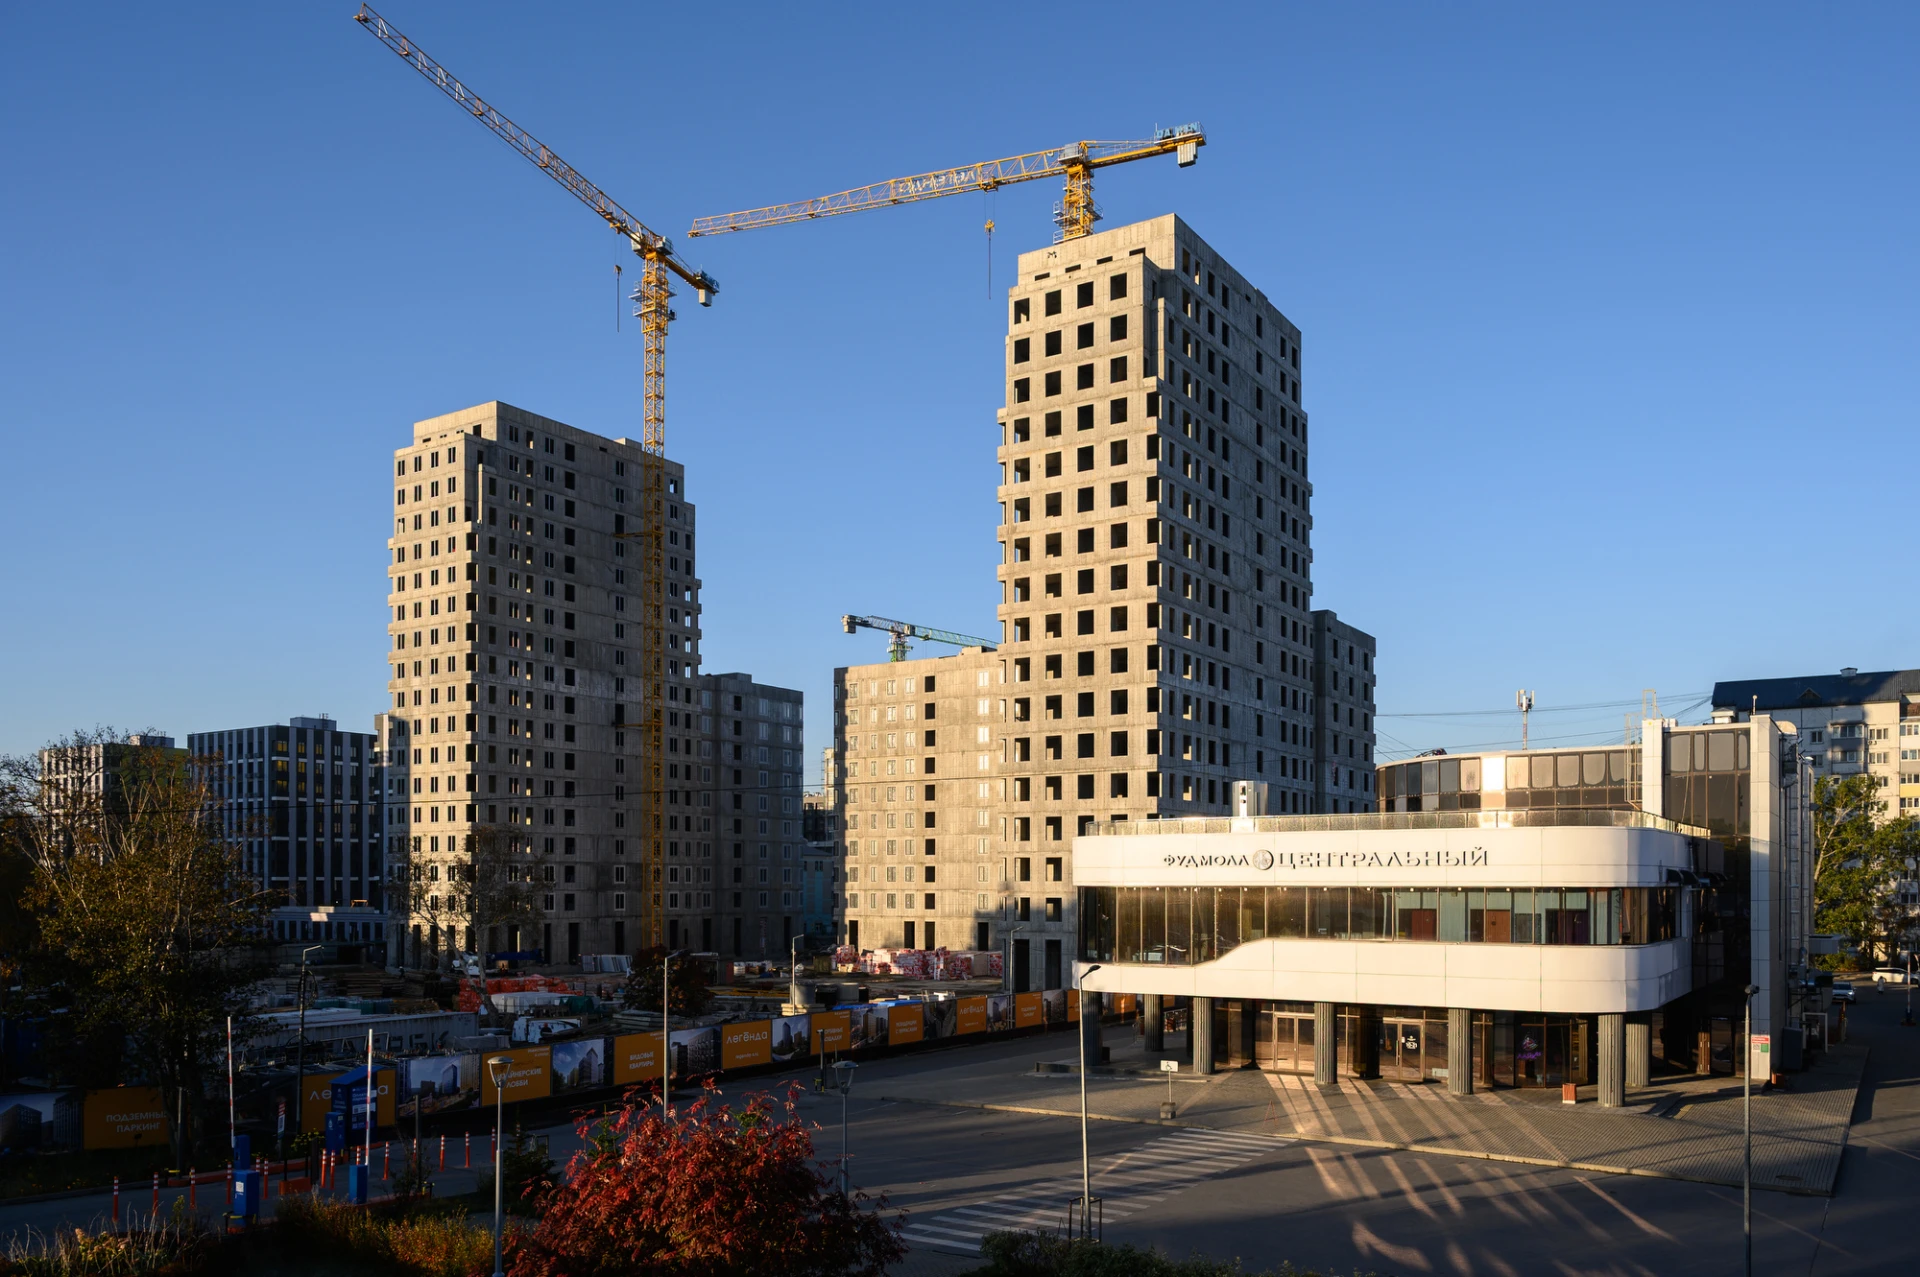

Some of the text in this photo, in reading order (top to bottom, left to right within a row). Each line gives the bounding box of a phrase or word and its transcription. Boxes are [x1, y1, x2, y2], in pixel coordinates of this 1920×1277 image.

[1163, 846, 1488, 870] ФУДМОЛЛ ЦЕНТРАЛЬНЫЙ
[629, 1051, 654, 1061] ВИДОВЫЕ
[628, 1060, 655, 1070] КВАРТИРЫ
[506, 1079, 528, 1089] ЛОББИ
[116, 1122, 161, 1133] ПАРКИНГ
